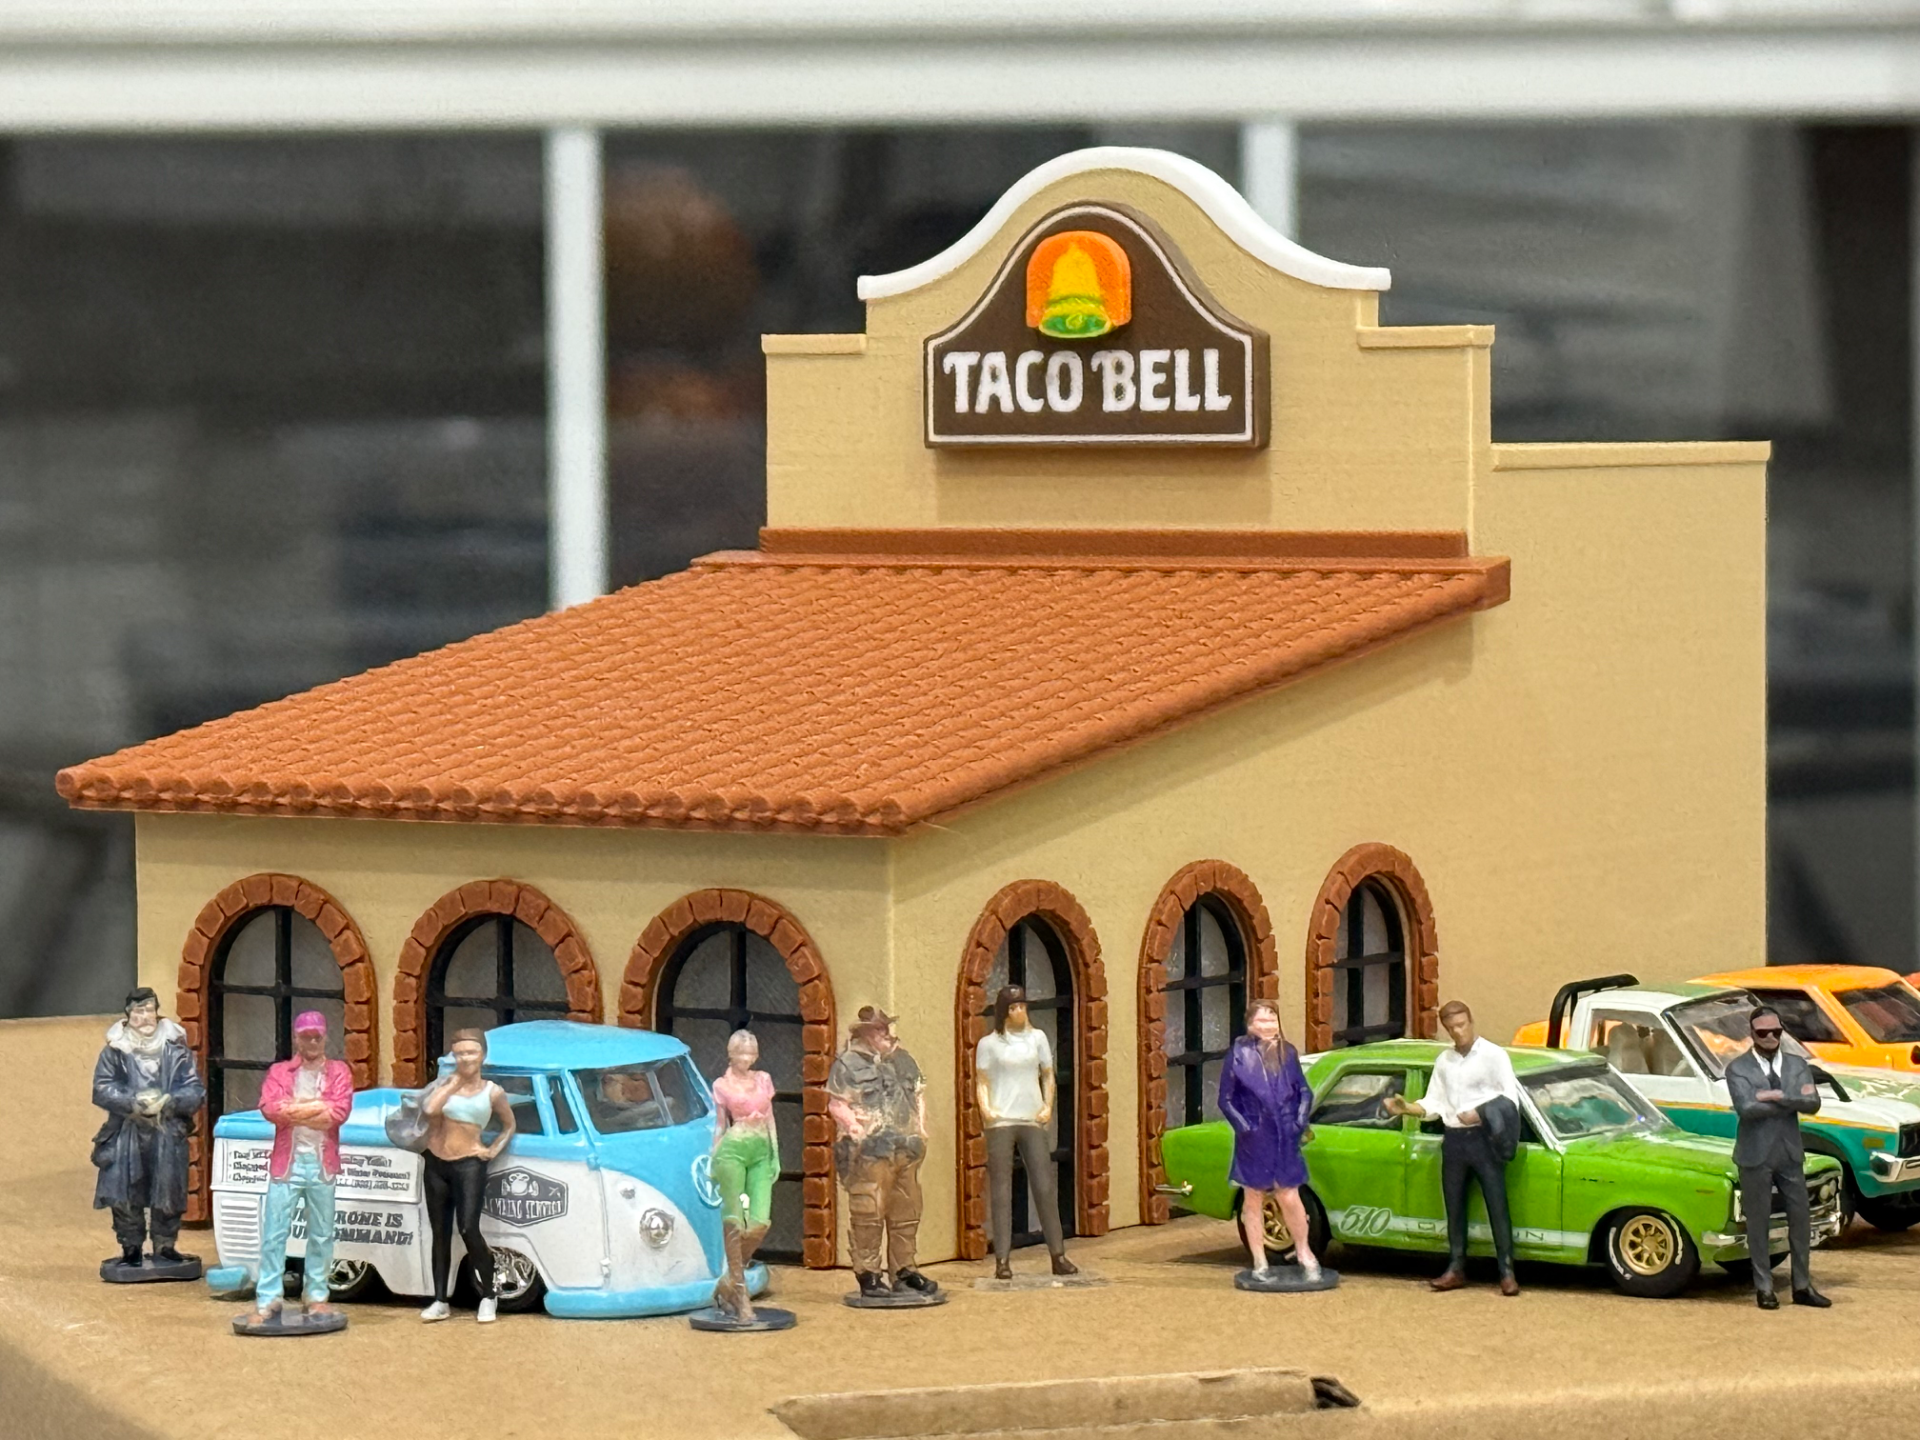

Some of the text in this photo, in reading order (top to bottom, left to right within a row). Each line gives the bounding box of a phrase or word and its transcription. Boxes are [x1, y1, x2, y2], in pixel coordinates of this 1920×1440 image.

[943, 348, 1232, 413] TACO BELL
[335, 1210, 404, 1229] RONE IS
[1339, 1205, 1391, 1236] 510
